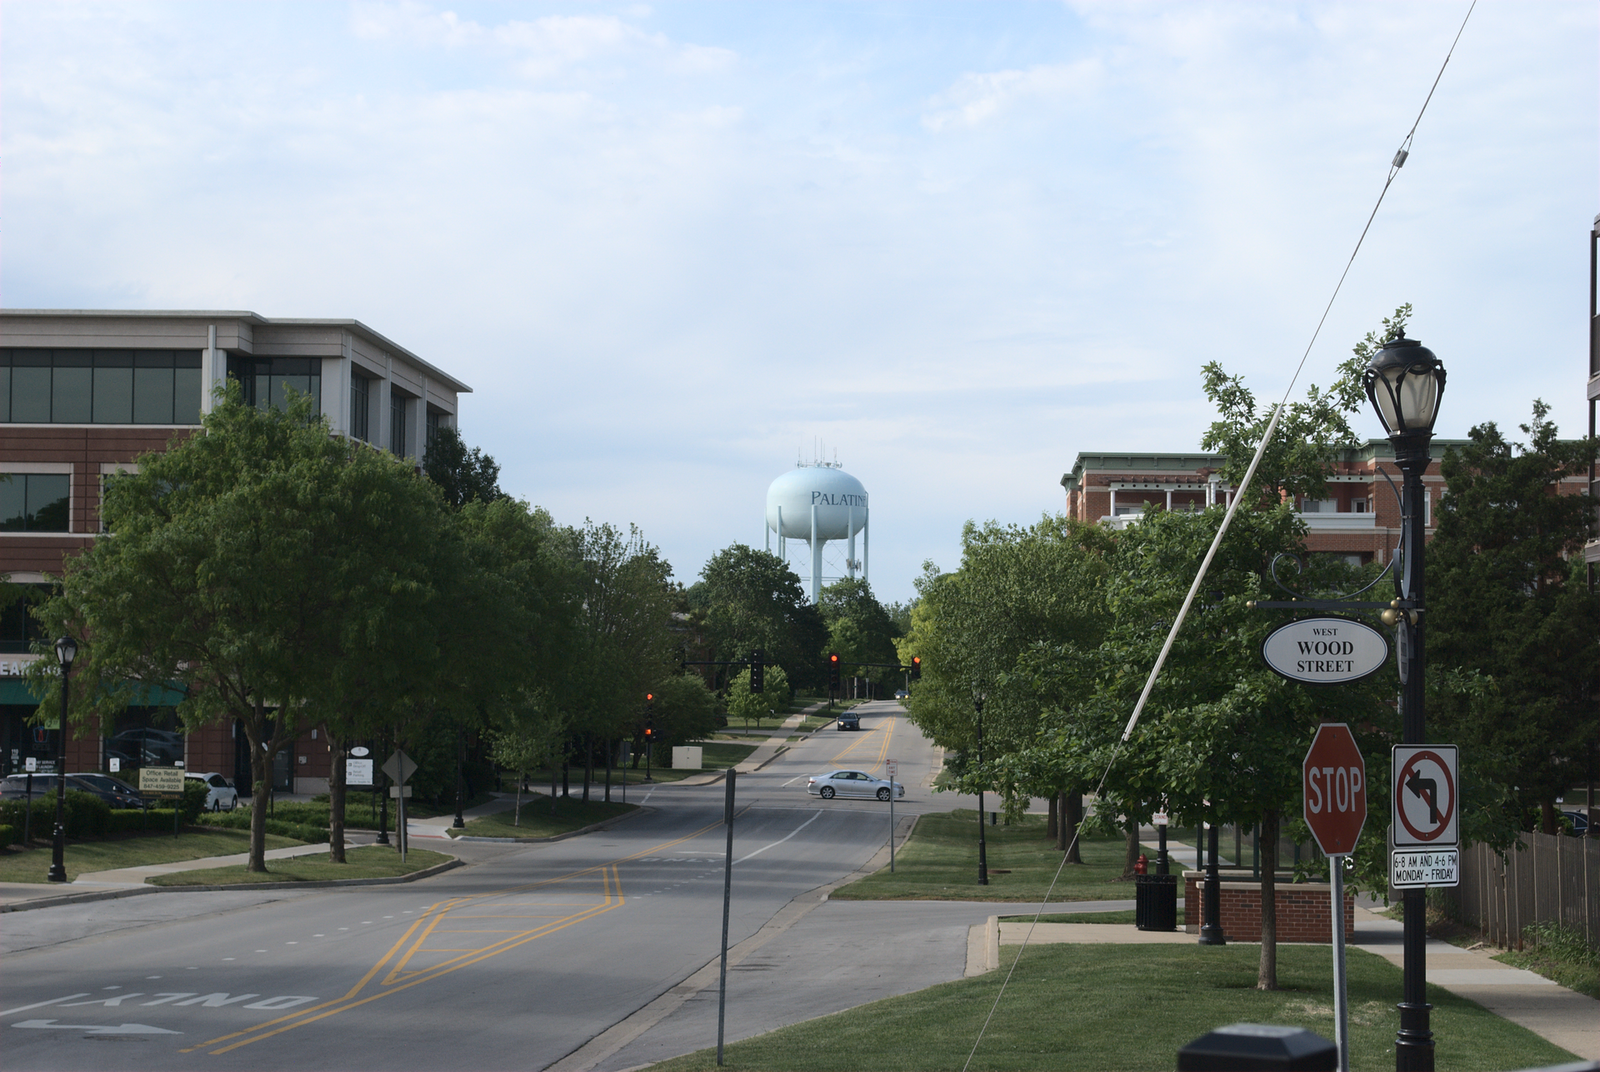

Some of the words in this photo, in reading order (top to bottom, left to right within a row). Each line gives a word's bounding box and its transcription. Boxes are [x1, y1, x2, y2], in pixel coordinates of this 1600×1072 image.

[1313, 628, 1338, 636] WEST
[1297, 641, 1354, 656] WOOD
[1297, 660, 1354, 672] STREET
[1309, 766, 1362, 814] STOP
[1394, 856, 1405, 868] 6-8
[1408, 856, 1417, 867] AM
[1420, 855, 1432, 867] AND
[1435, 855, 1445, 866] 4-6
[1448, 855, 1457, 866] PM
[1396, 869, 1424, 881] MONDAY
[1431, 868, 1454, 880] FRIDAY
[57, 992, 319, 1010] ONLY
